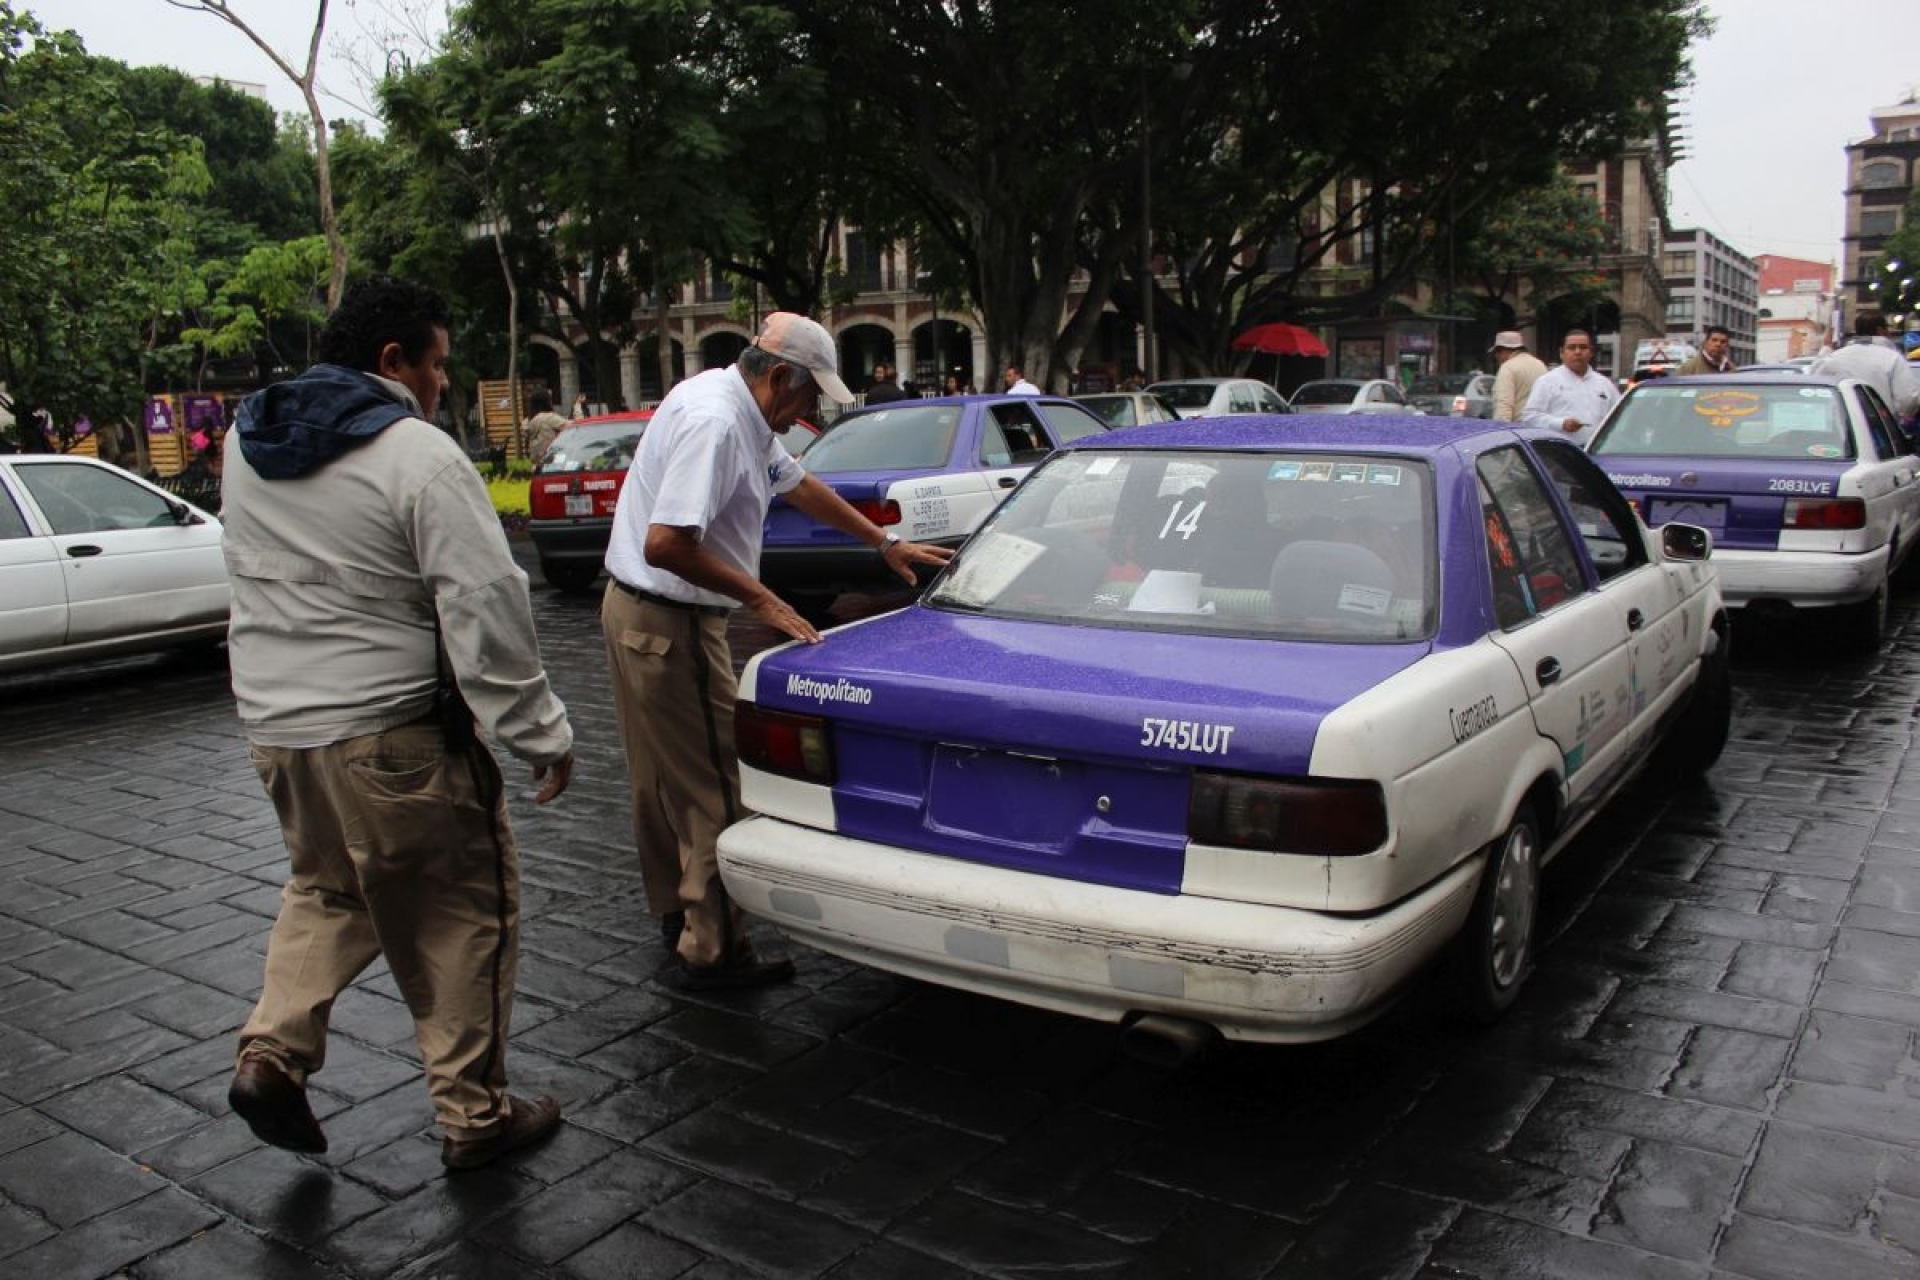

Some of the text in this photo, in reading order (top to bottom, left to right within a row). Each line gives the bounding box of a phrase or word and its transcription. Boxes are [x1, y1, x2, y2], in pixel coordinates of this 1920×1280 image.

[1768, 479, 1831, 494] 2083LVE
[1159, 500, 1206, 540] 14
[786, 673, 872, 705] Metropolitano
[1140, 717, 1235, 755] 5745LUT
[1449, 694, 1499, 744] Cuernavaca
